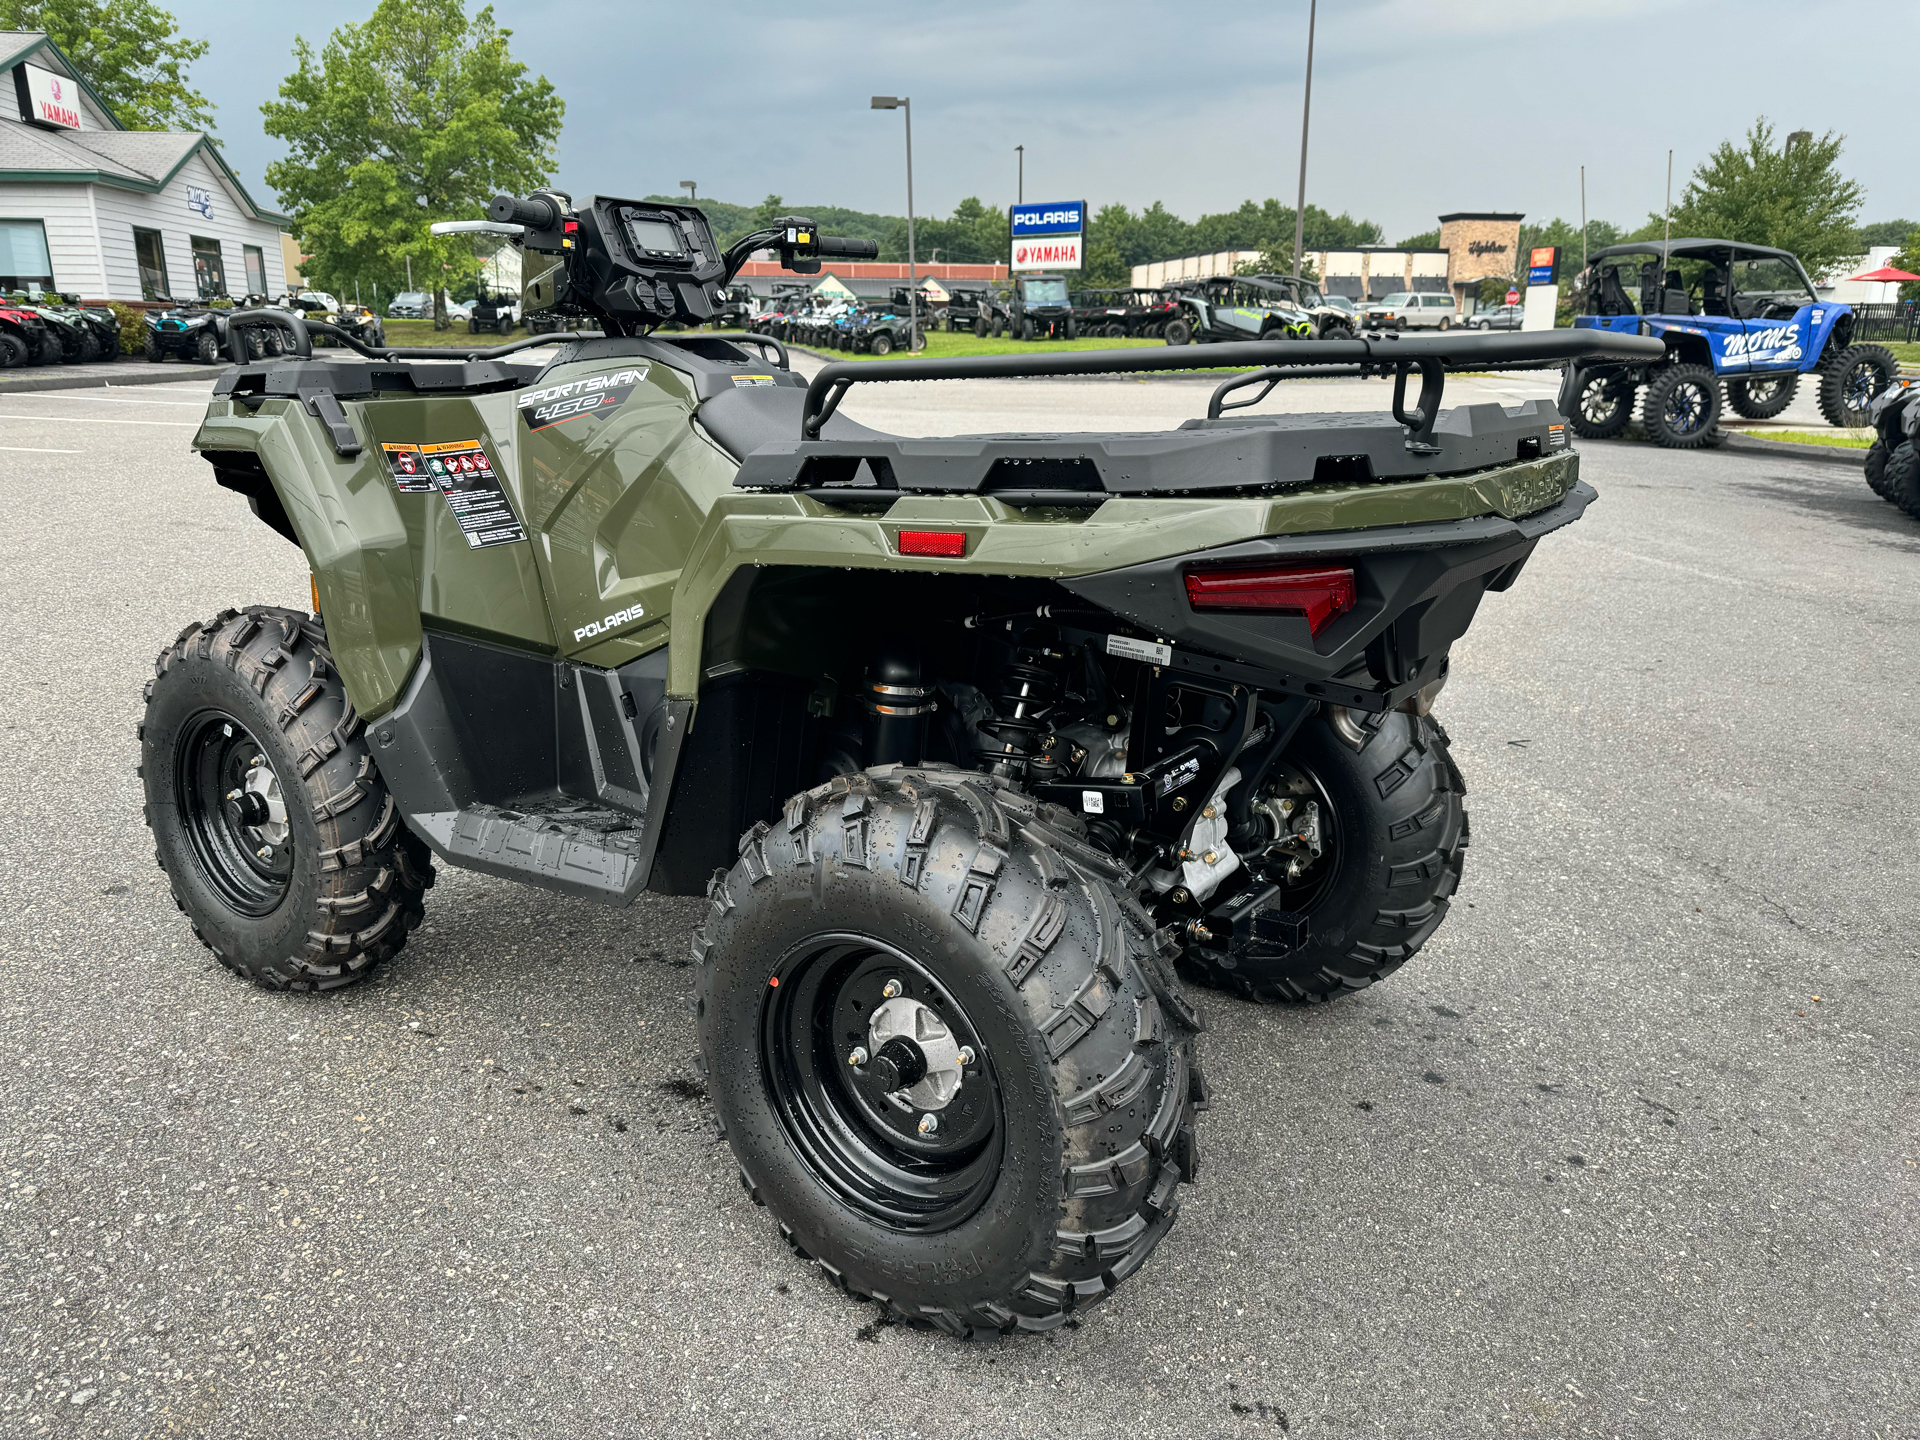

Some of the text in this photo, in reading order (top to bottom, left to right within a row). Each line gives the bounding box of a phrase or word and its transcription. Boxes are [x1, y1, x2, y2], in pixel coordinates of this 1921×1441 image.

[39, 100, 80, 128] YAMAHA
[1014, 211, 1079, 226] POLARIS
[1029, 245, 1077, 262] YAMAHA
[1723, 323, 1800, 357] MOMS
[517, 368, 650, 409] SPORTSMAN
[535, 392, 605, 420] 450
[573, 604, 644, 642] POLARIS
